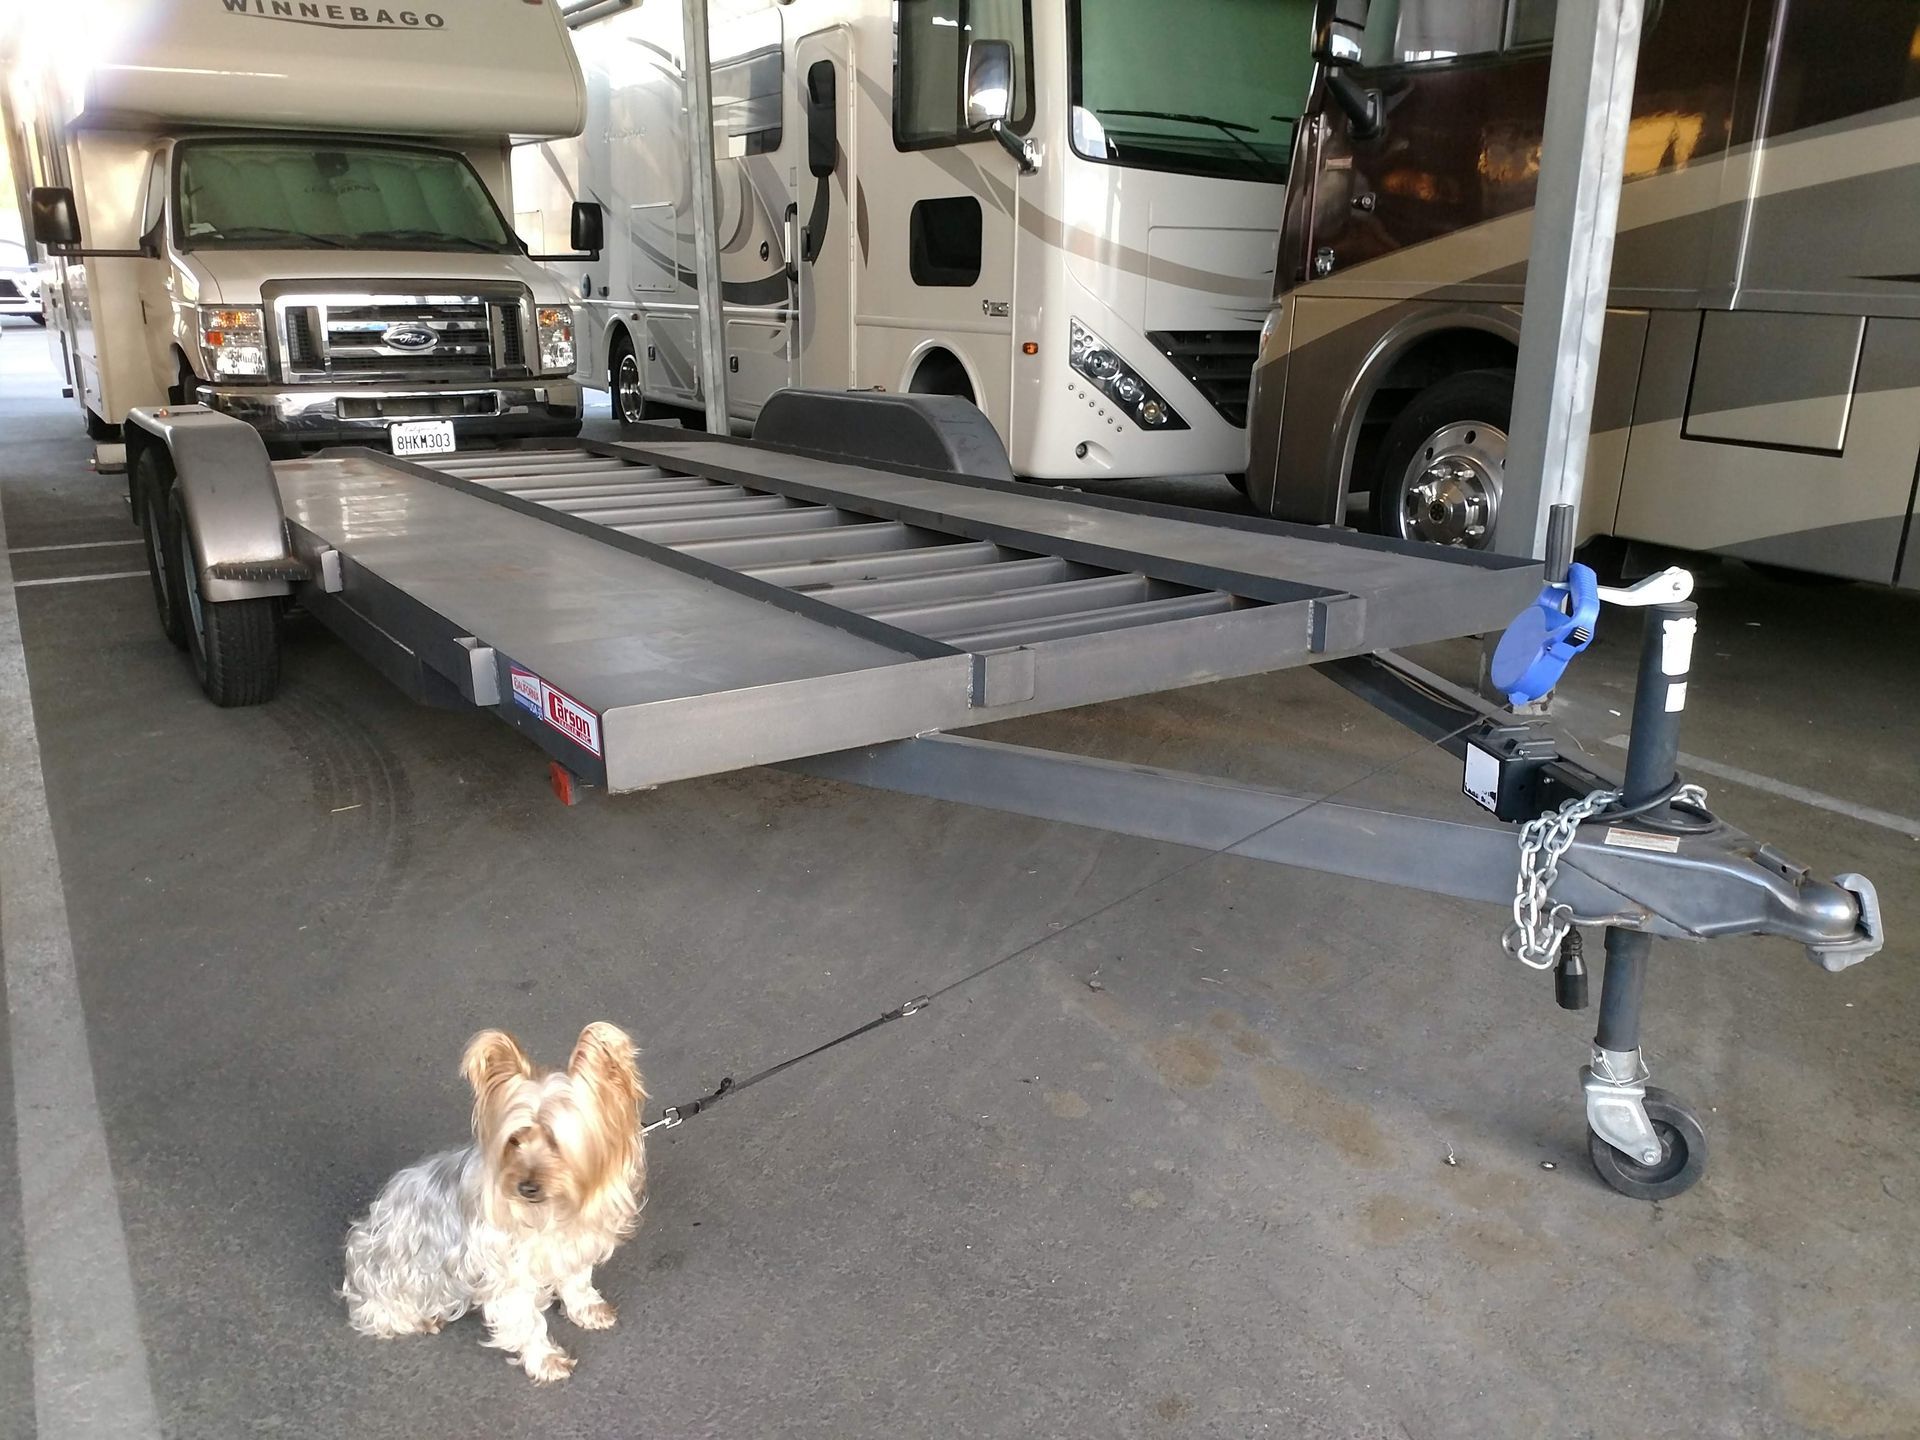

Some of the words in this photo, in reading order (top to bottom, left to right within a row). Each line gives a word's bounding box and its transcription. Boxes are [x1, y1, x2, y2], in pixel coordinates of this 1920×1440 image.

[222, 0, 445, 28] WINNEBAGO
[399, 333, 426, 344] Ford
[397, 433, 451, 450] 8HKM303
[549, 691, 591, 738] Carson
